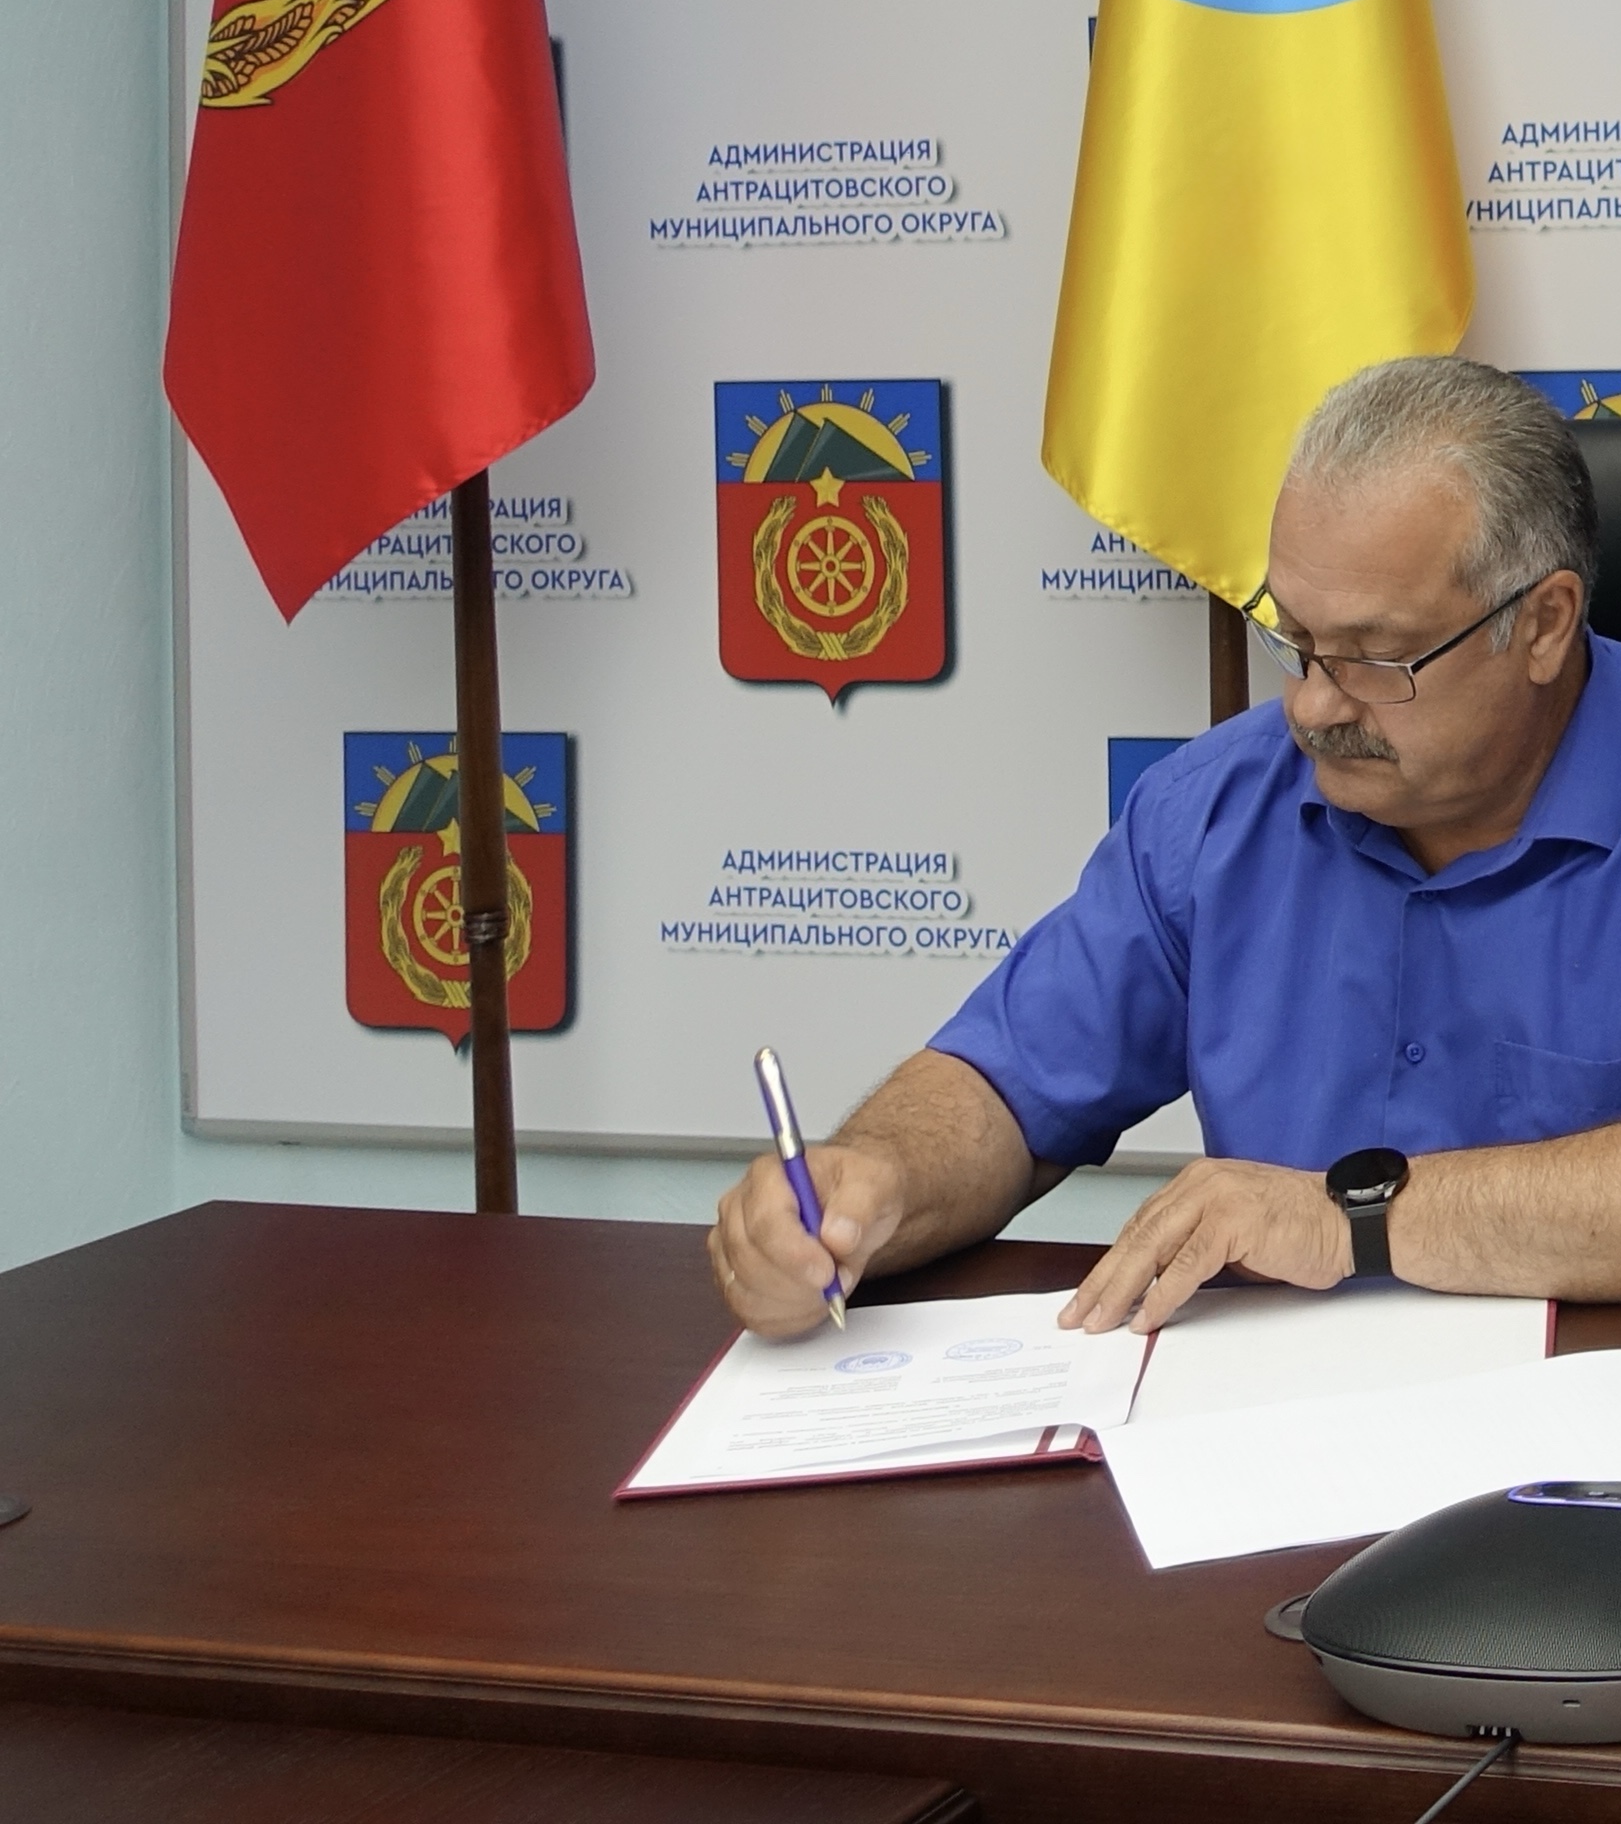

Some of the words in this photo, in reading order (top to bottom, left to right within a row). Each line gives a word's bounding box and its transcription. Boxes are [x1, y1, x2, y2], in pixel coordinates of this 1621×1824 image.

[708, 139, 931, 169] АДМИНИСТРАЦИЯ
[696, 175, 947, 204] АНТРАЦИТОВСКОГО
[649, 213, 893, 241] МУНИЦИПАЛЬНОГО
[900, 210, 998, 233] ОКРУГА
[531, 569, 625, 590] ОКРУГА
[1041, 568, 1198, 594] МУНИЦИПА
[722, 849, 948, 877] АДМИНИСТРАЦИЯ
[708, 886, 962, 912] АНТРАЦИТОВСКОГО
[660, 921, 907, 949] МУНИЦИПАЛЬНОГО
[915, 927, 1012, 950] ОКРУГА
